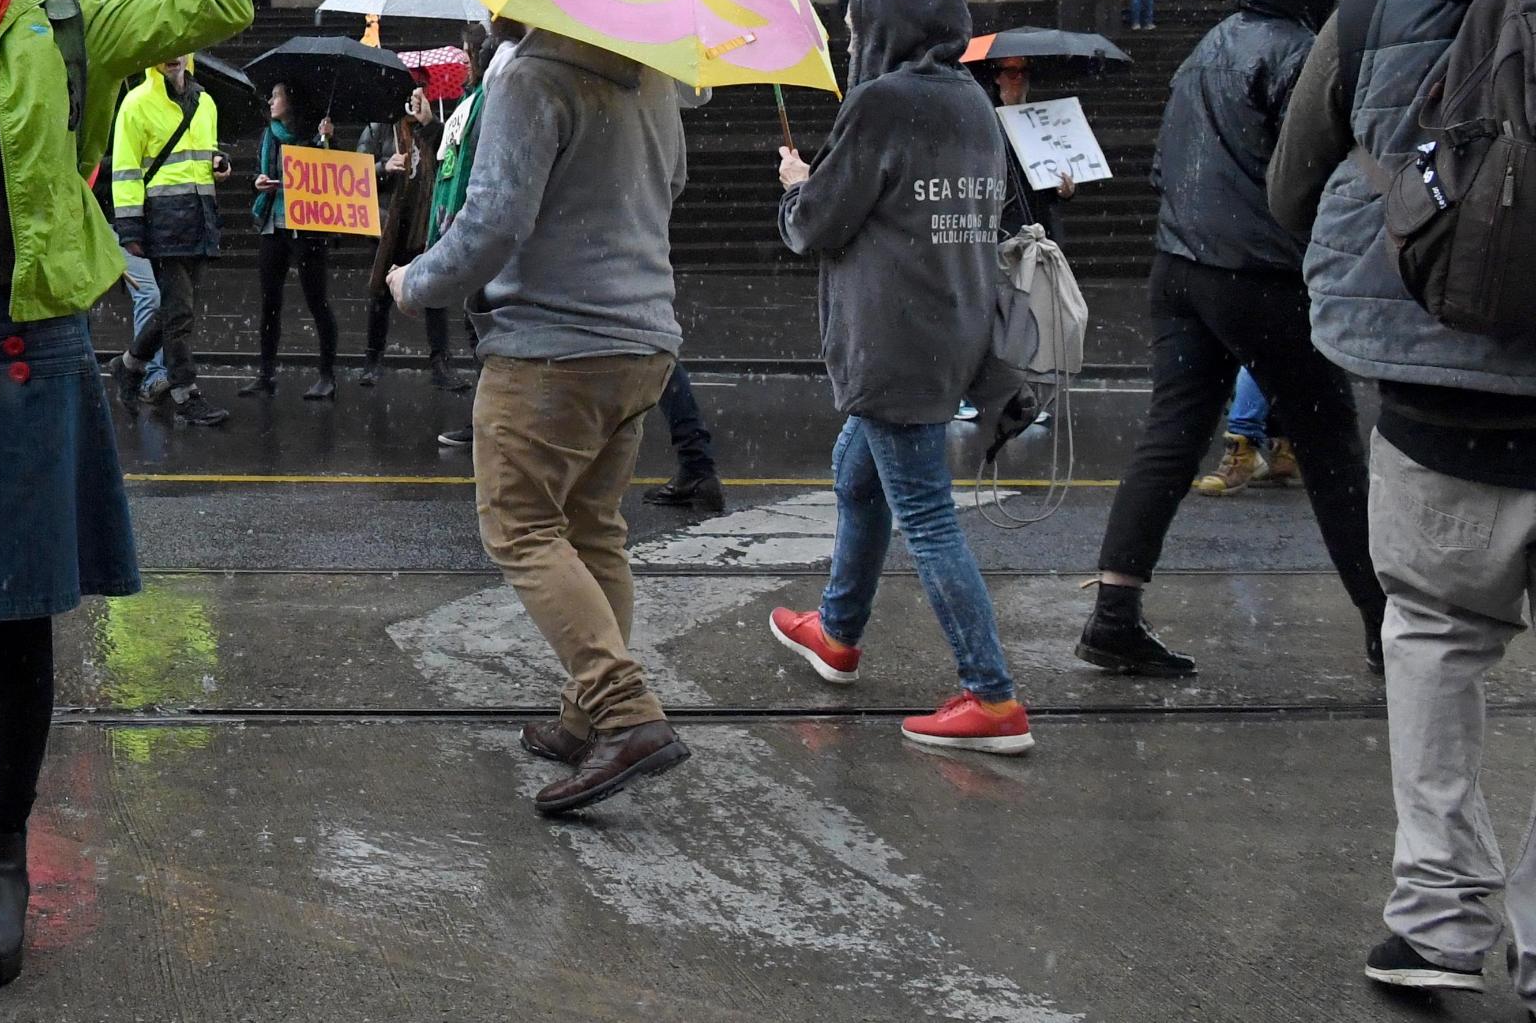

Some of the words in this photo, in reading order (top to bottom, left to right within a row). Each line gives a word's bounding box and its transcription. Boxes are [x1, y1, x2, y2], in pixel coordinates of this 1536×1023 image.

[284, 155, 370, 198] POLITICS
[913, 178, 952, 201] SEA
[289, 199, 370, 229] BEYOND
[931, 230, 974, 244] WILDLIFE
